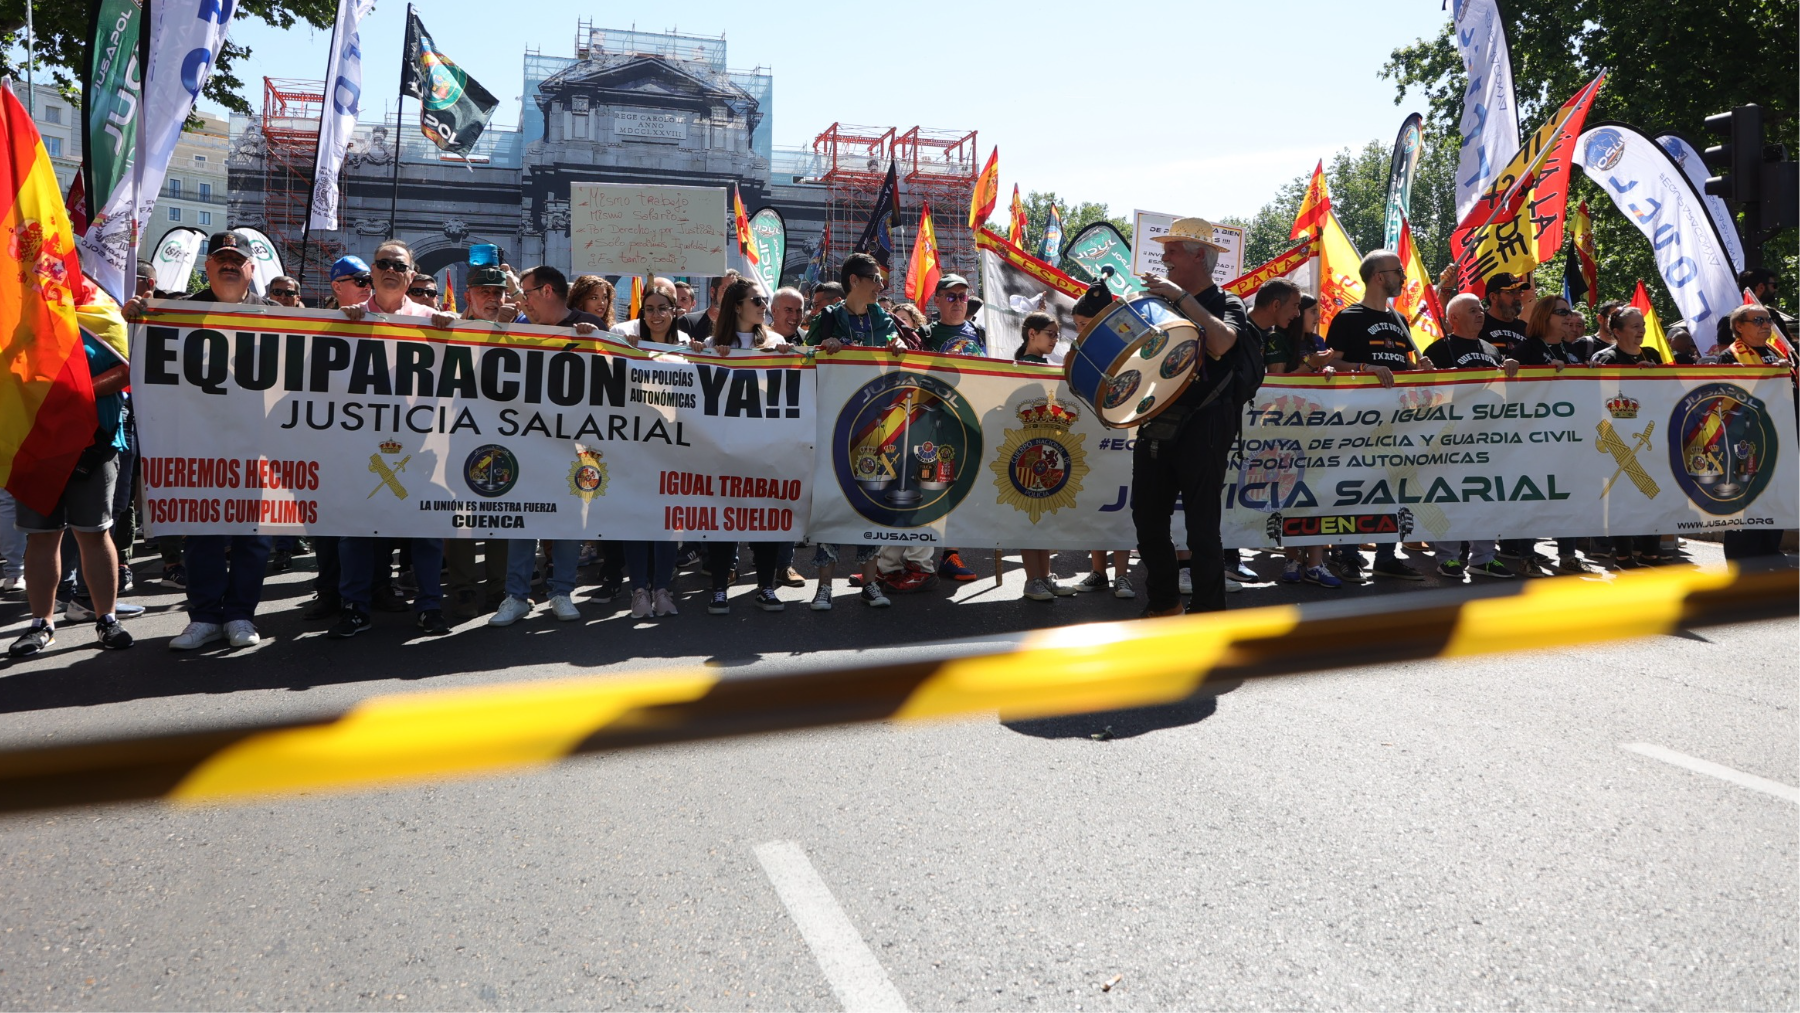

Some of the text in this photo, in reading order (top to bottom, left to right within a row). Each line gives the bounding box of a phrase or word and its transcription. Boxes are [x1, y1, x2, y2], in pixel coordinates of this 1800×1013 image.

[95, 9, 132, 96] JUSAPOL
[421, 110, 462, 146] POL
[614, 112, 637, 121] REGE
[640, 114, 675, 123] CAROLO
[619, 127, 682, 137] MDCCLXXVIII
[589, 187, 631, 208] Mismo
[586, 224, 605, 235] Por
[658, 228, 673, 240] por
[1150, 226, 1162, 234] DE
[1221, 229, 1241, 237] BIEN
[1496, 214, 1529, 265] DE
[619, 252, 648, 263] tanto
[1229, 256, 1296, 294] PAÑA
[1367, 323, 1381, 335] QUE
[1379, 322, 1389, 330] TE
[1502, 329, 1511, 337] TE
[144, 326, 627, 408] EQUIPARACIÓN
[1457, 353, 1472, 365] QUE
[1471, 352, 1480, 360] TE
[630, 368, 694, 388] CON POLICÍAS
[630, 388, 697, 409] AUTONÓMICAS
[697, 364, 801, 419] YA!!
[863, 375, 960, 409] JUSAPOL
[1685, 385, 1759, 411] JUSAPOL
[281, 399, 691, 448] JUSTICIA SALARIAL
[1247, 401, 1576, 428] TRABAJO, IGUAL SUELDO
[1308, 438, 1334, 451] DE
[1338, 434, 1416, 449] POLICIA
[1420, 434, 1435, 447] Y
[1440, 432, 1524, 447] GUARDIA
[1529, 430, 1584, 443] CIVIL
[1012, 441, 1033, 464] CUERPO
[1036, 439, 1064, 455] NACIONAL
[1248, 455, 1341, 471] POLICIAS
[1346, 451, 1491, 469] AUTONOMICAS
[246, 459, 319, 490] HECHOS
[659, 471, 801, 502] IGUAL TRABAJO
[1333, 474, 1572, 507] SALARIAL
[224, 499, 318, 525] CUMPLIMOS
[419, 498, 557, 513] LA UNIÓN ES NUESTRA FUERZA
[452, 515, 525, 529] CUENCA
[664, 506, 794, 532] IGUAL SUELDO
[1282, 515, 1397, 536] CUENCA
[1677, 517, 1775, 530] WWW.JUSAPOL.ORG
[863, 530, 937, 543] @JUSAPOL
